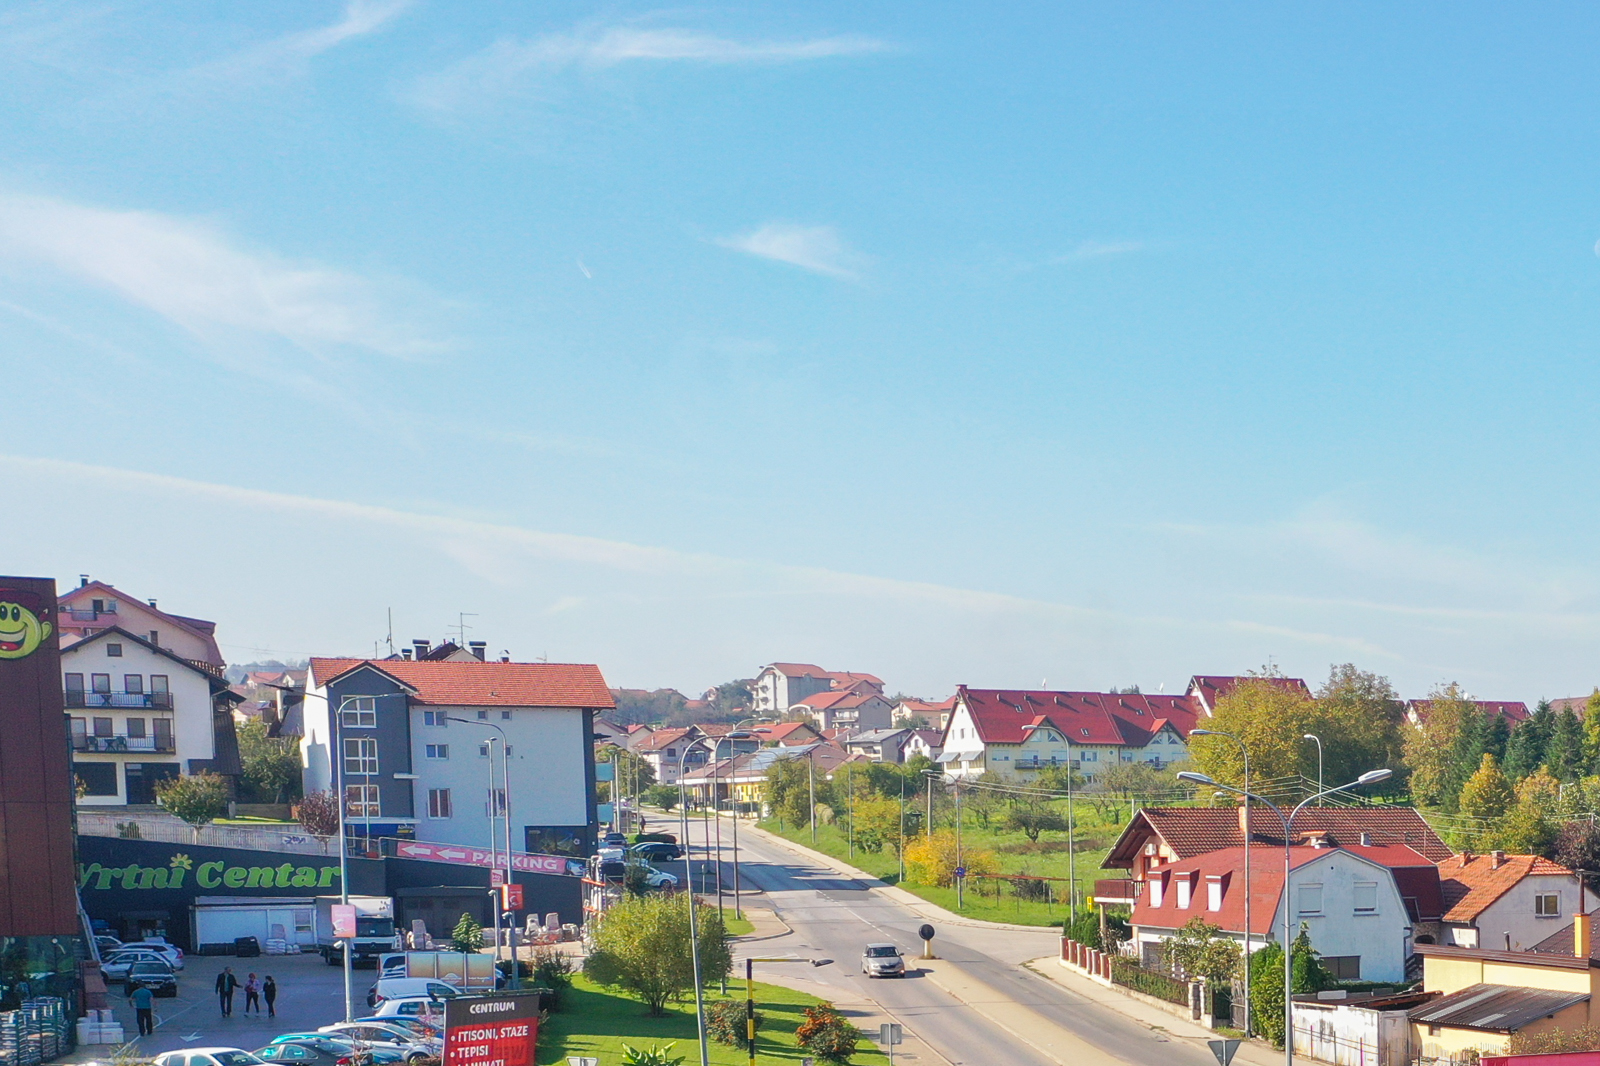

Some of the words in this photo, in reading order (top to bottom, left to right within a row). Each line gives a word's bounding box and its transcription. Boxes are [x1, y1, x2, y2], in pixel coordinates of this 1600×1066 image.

[472, 852, 558, 870] PARKING
[80, 855, 183, 890] Vrtni
[196, 861, 341, 889] Centar
[470, 1002, 515, 1014] CENTRUM
[458, 1028, 498, 1042] ITISONI,
[500, 1025, 528, 1038] STAZE
[457, 1045, 488, 1058] TEPISI
